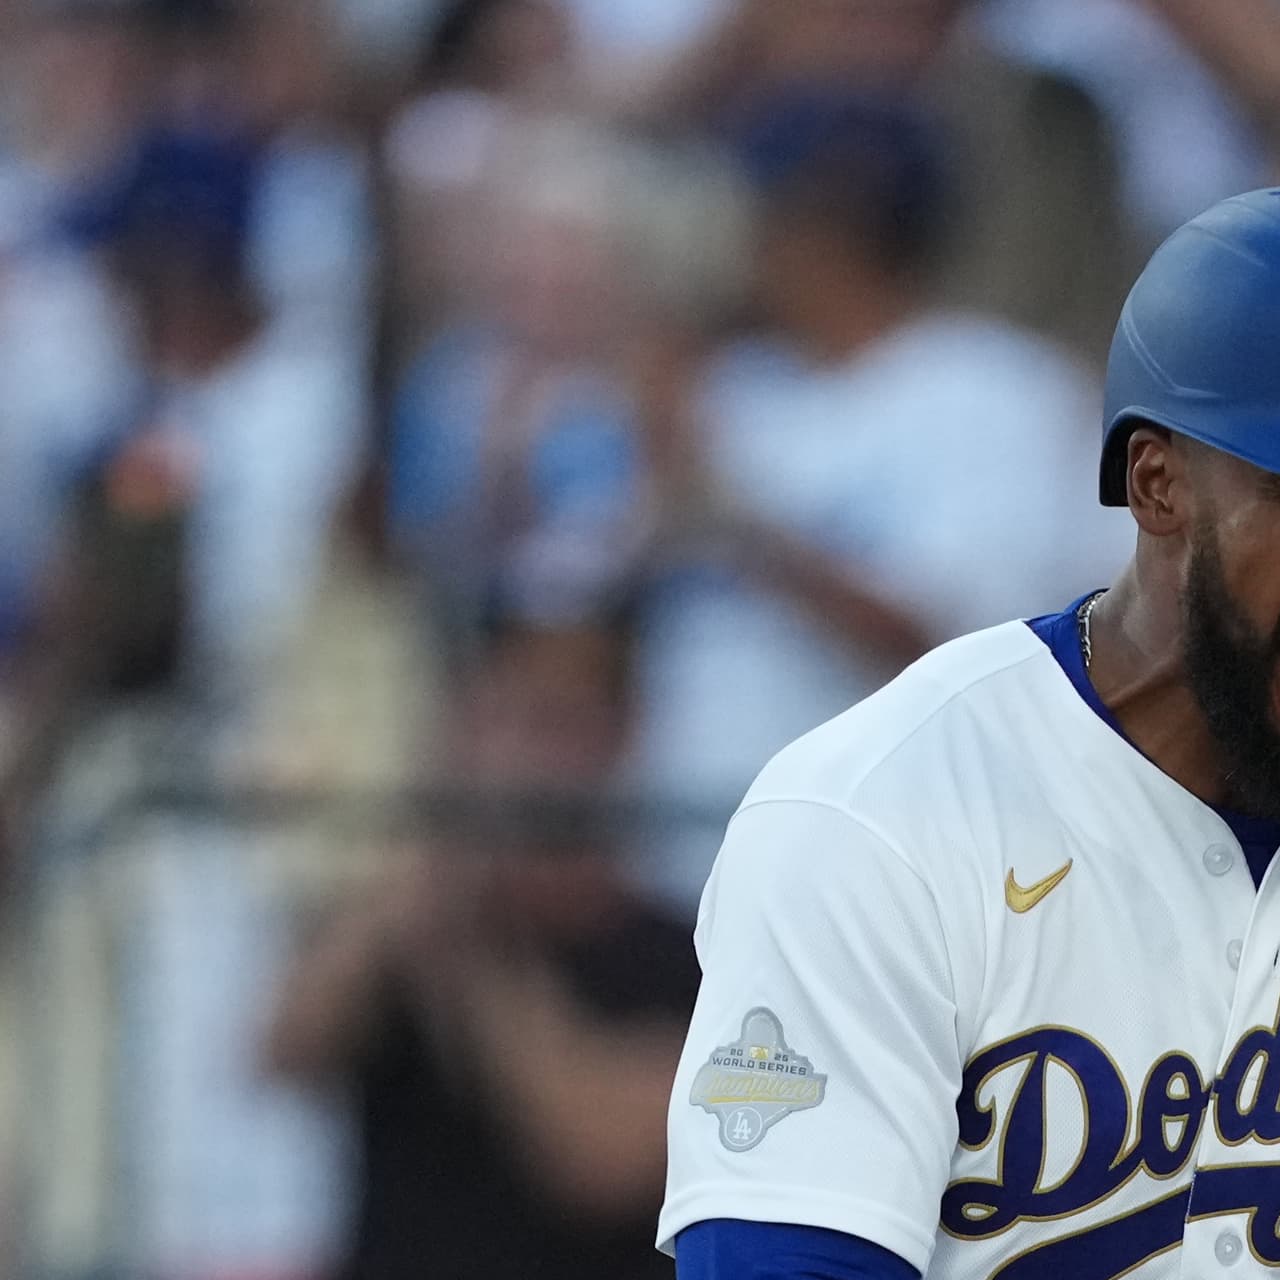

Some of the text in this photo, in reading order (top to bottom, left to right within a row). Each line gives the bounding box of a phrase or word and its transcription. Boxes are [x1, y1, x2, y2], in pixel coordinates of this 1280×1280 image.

[712, 1056, 807, 1077] WORLD SERIES
[733, 1111, 751, 1140] LA
